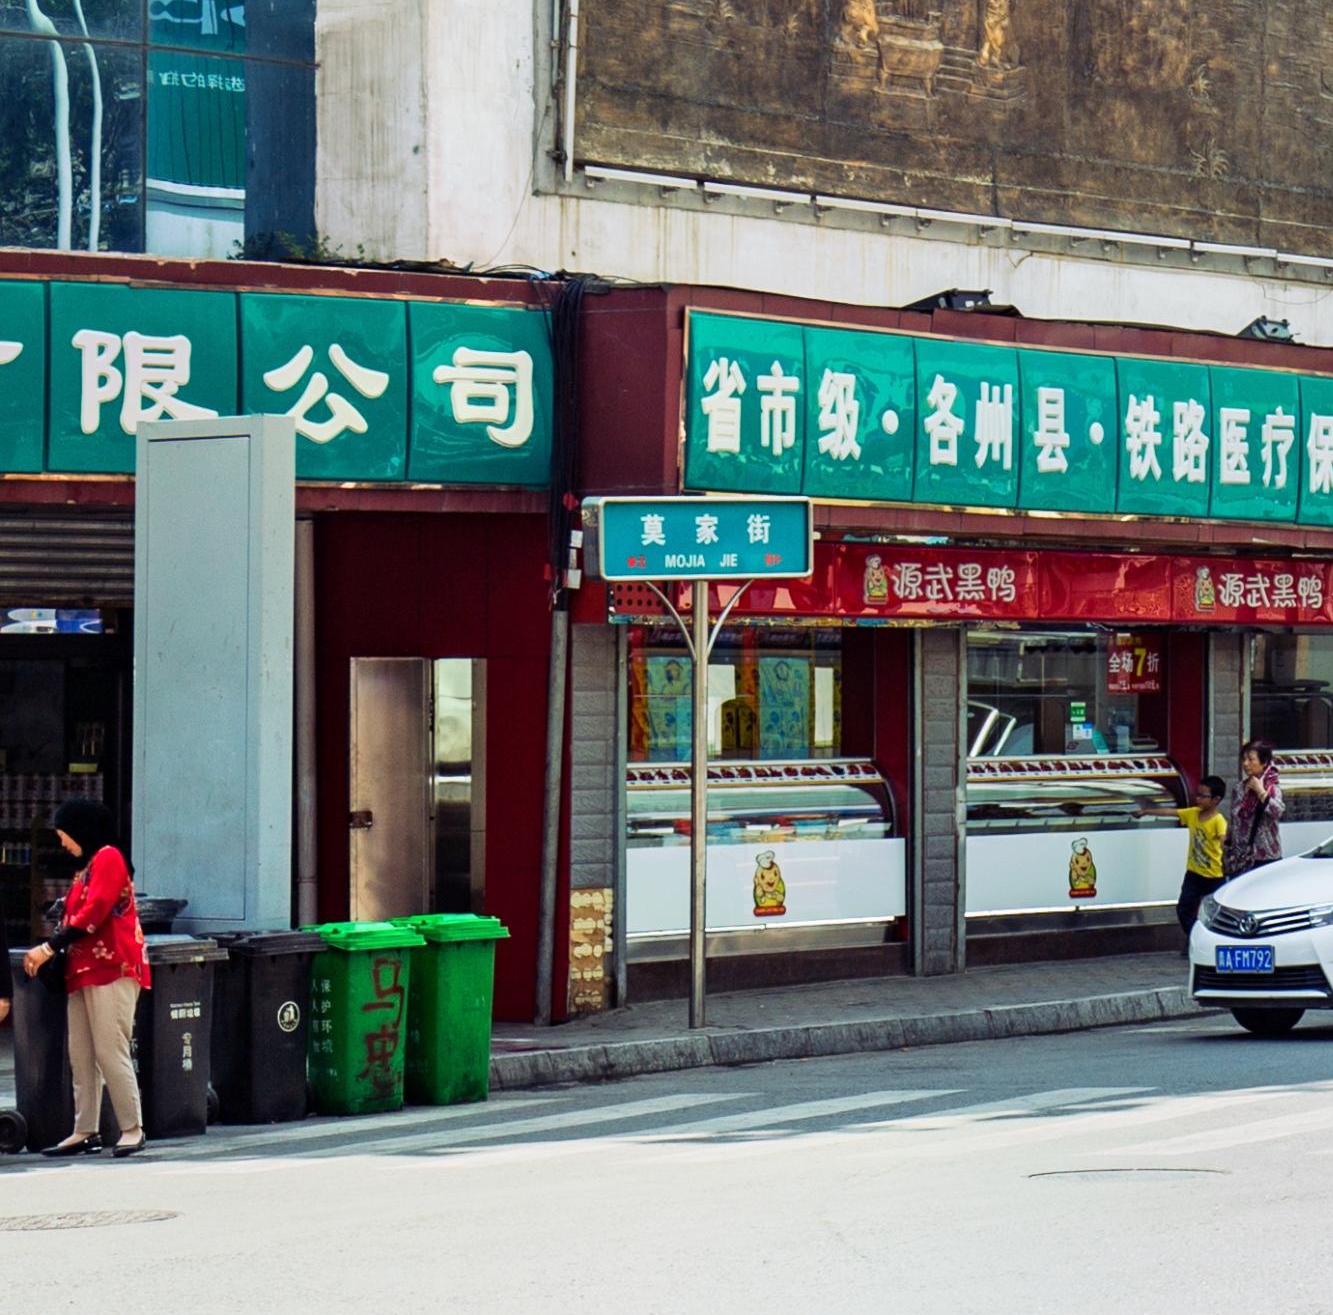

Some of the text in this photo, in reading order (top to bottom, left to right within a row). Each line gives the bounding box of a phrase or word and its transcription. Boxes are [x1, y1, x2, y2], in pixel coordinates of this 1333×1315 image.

[0, 329, 535, 448] 限公司
[640, 513, 771, 546] 莫家街
[665, 554, 738, 568] MOJIA JIE
[891, 561, 1016, 604] 源武黑鸭
[1219, 571, 1324, 612] 源武黑鸭
[1109, 648, 1160, 676] 全场7折
